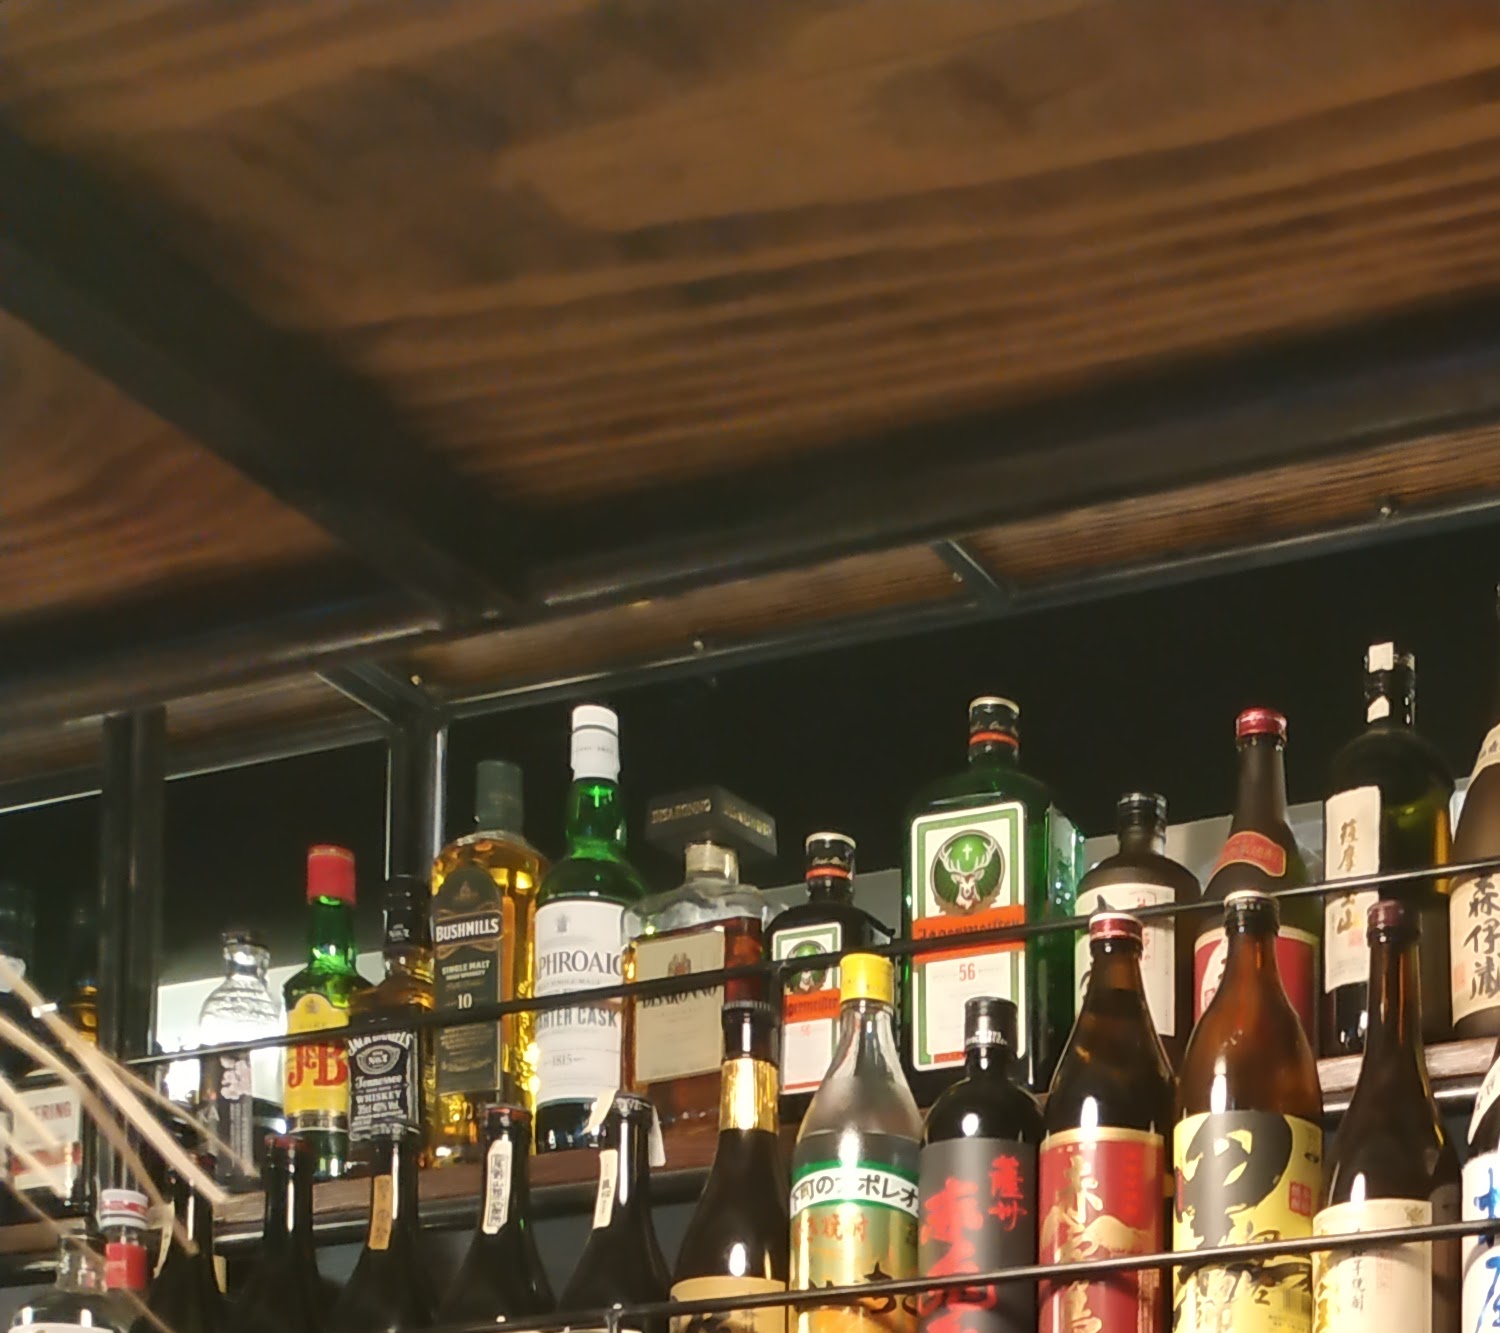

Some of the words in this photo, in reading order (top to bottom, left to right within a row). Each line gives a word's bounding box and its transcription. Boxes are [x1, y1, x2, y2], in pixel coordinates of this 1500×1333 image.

[436, 918, 500, 942] BUSHMILLS
[959, 963, 976, 981] 56
[457, 993, 473, 1010] 10
[577, 1007, 618, 1028] CASK
